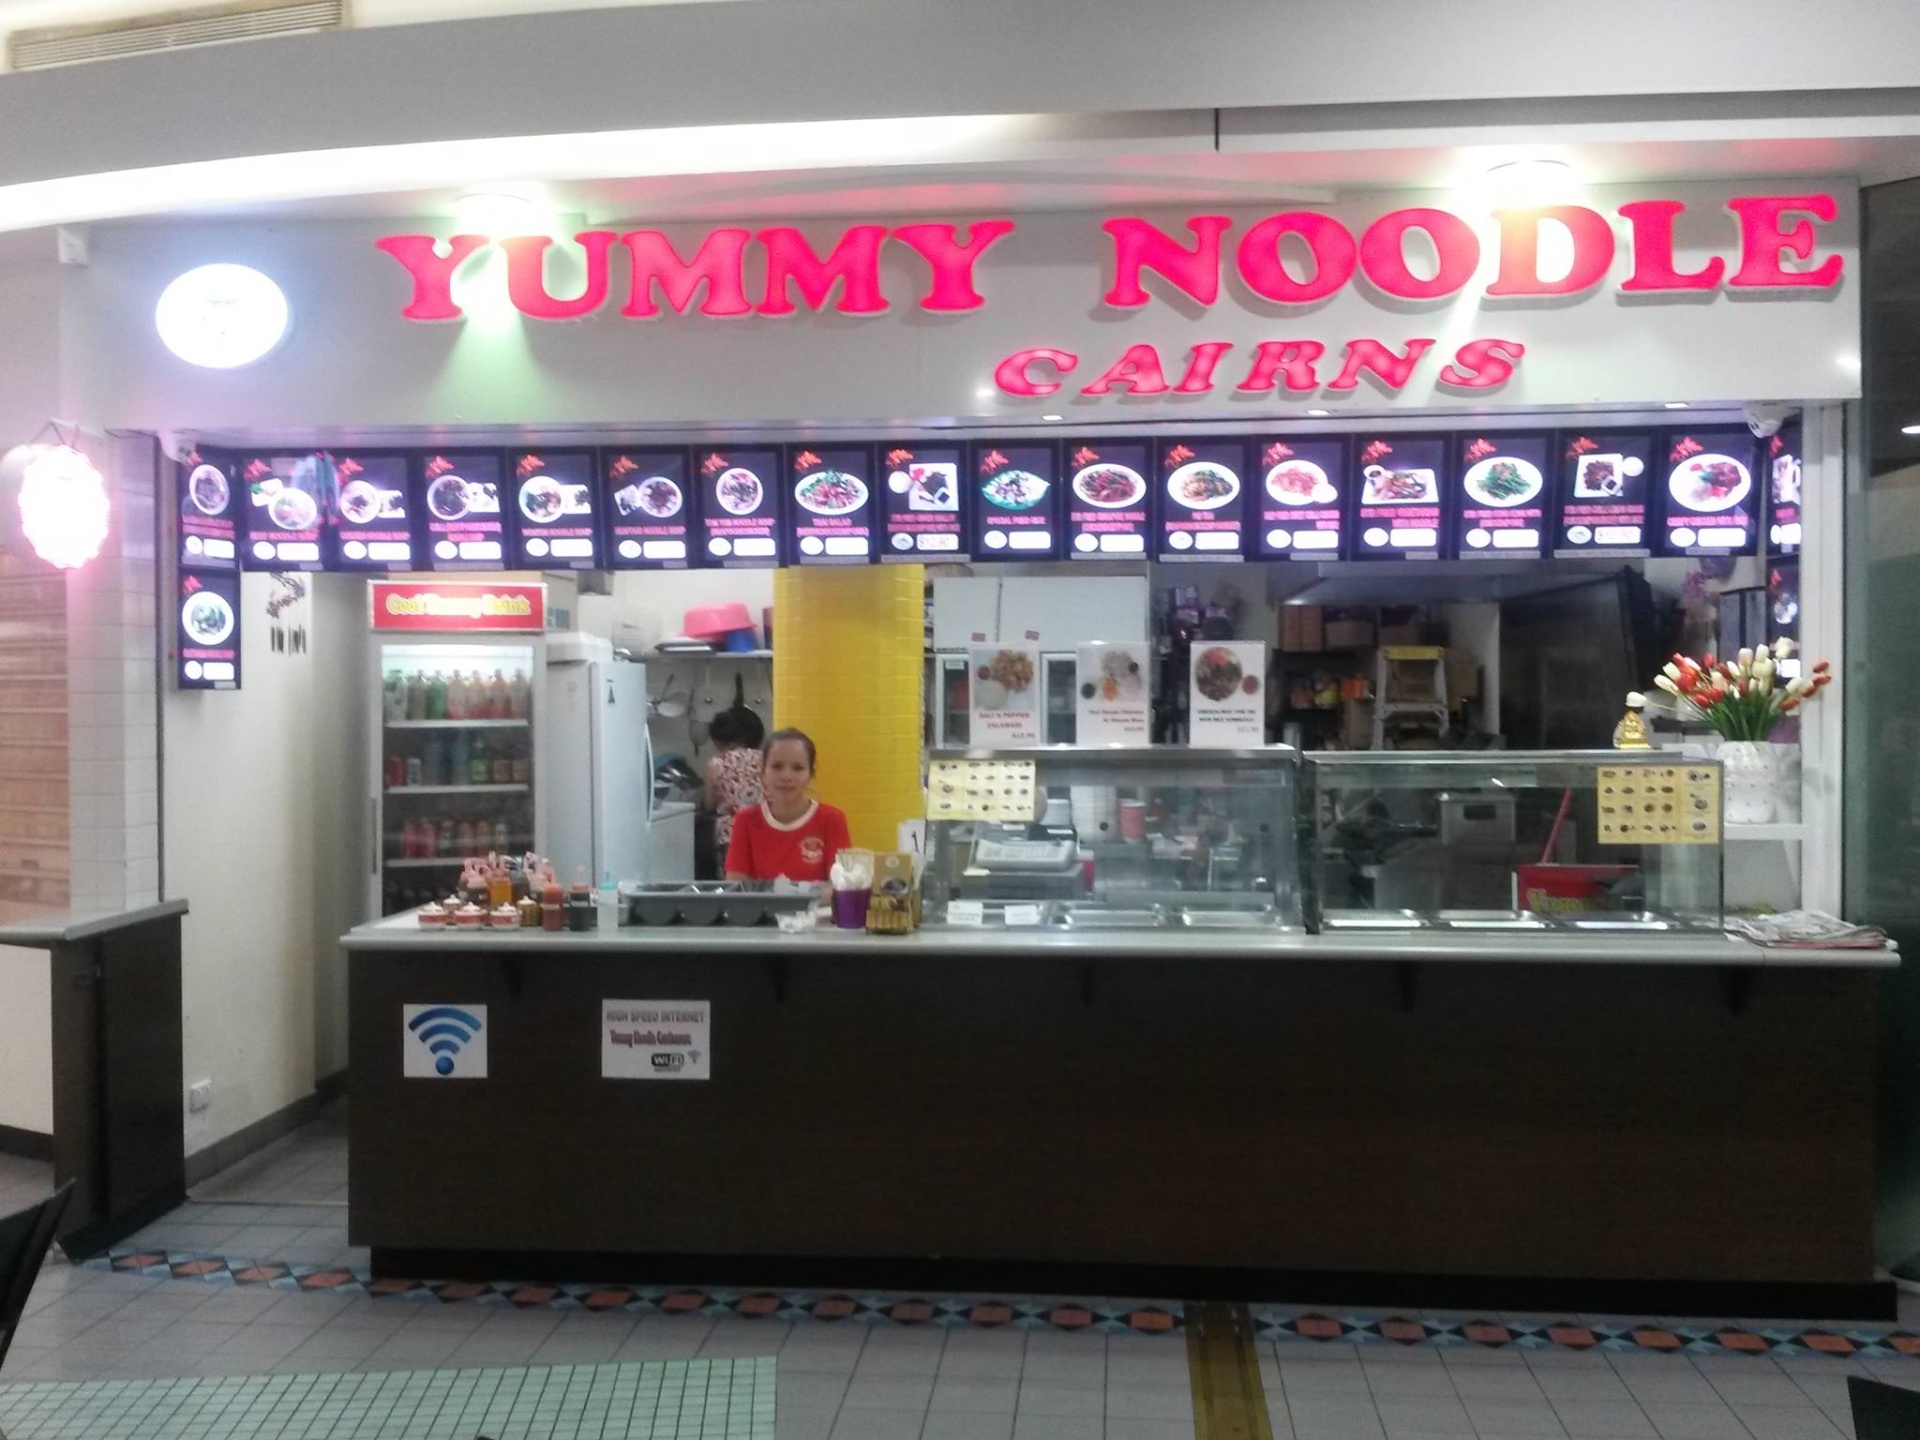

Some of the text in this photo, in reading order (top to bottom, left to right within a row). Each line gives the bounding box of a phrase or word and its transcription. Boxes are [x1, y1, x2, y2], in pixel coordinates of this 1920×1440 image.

[376, 194, 1843, 321] YUMMY NOODLE
[994, 338, 1527, 398] CAIRNS
[631, 1010, 658, 1022] SPEED
[660, 1010, 704, 1023] INTERNET
